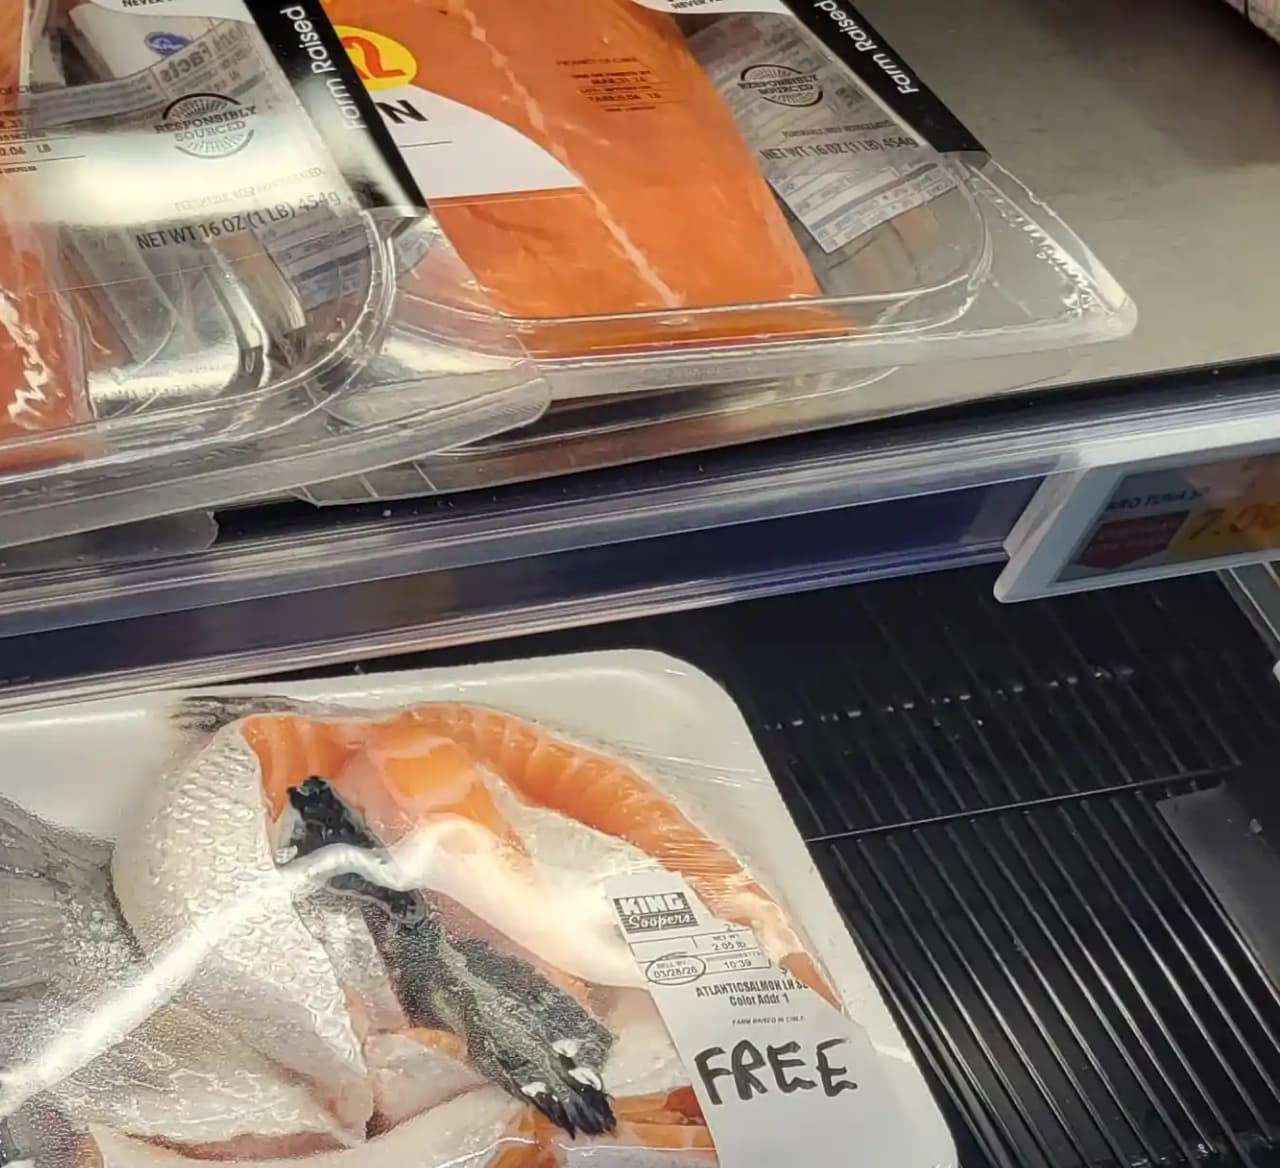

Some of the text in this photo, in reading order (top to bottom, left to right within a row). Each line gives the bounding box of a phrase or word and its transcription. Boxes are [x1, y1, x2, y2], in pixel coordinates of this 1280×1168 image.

[280, 6, 368, 129] Farm Raised
[814, 0, 920, 94] Farm Raised
[154, 105, 257, 134] RESPONSIBLY
[174, 121, 246, 142] SOURCED
[136, 231, 171, 250] NET
[171, 225, 198, 243] WT
[198, 221, 221, 239] 16
[223, 216, 244, 233] OZ
[267, 203, 296, 221] LB)
[299, 190, 341, 210] 454g
[619, 894, 684, 915] KING
[629, 914, 691, 929] Soopers
[694, 1039, 857, 1105] FREE
